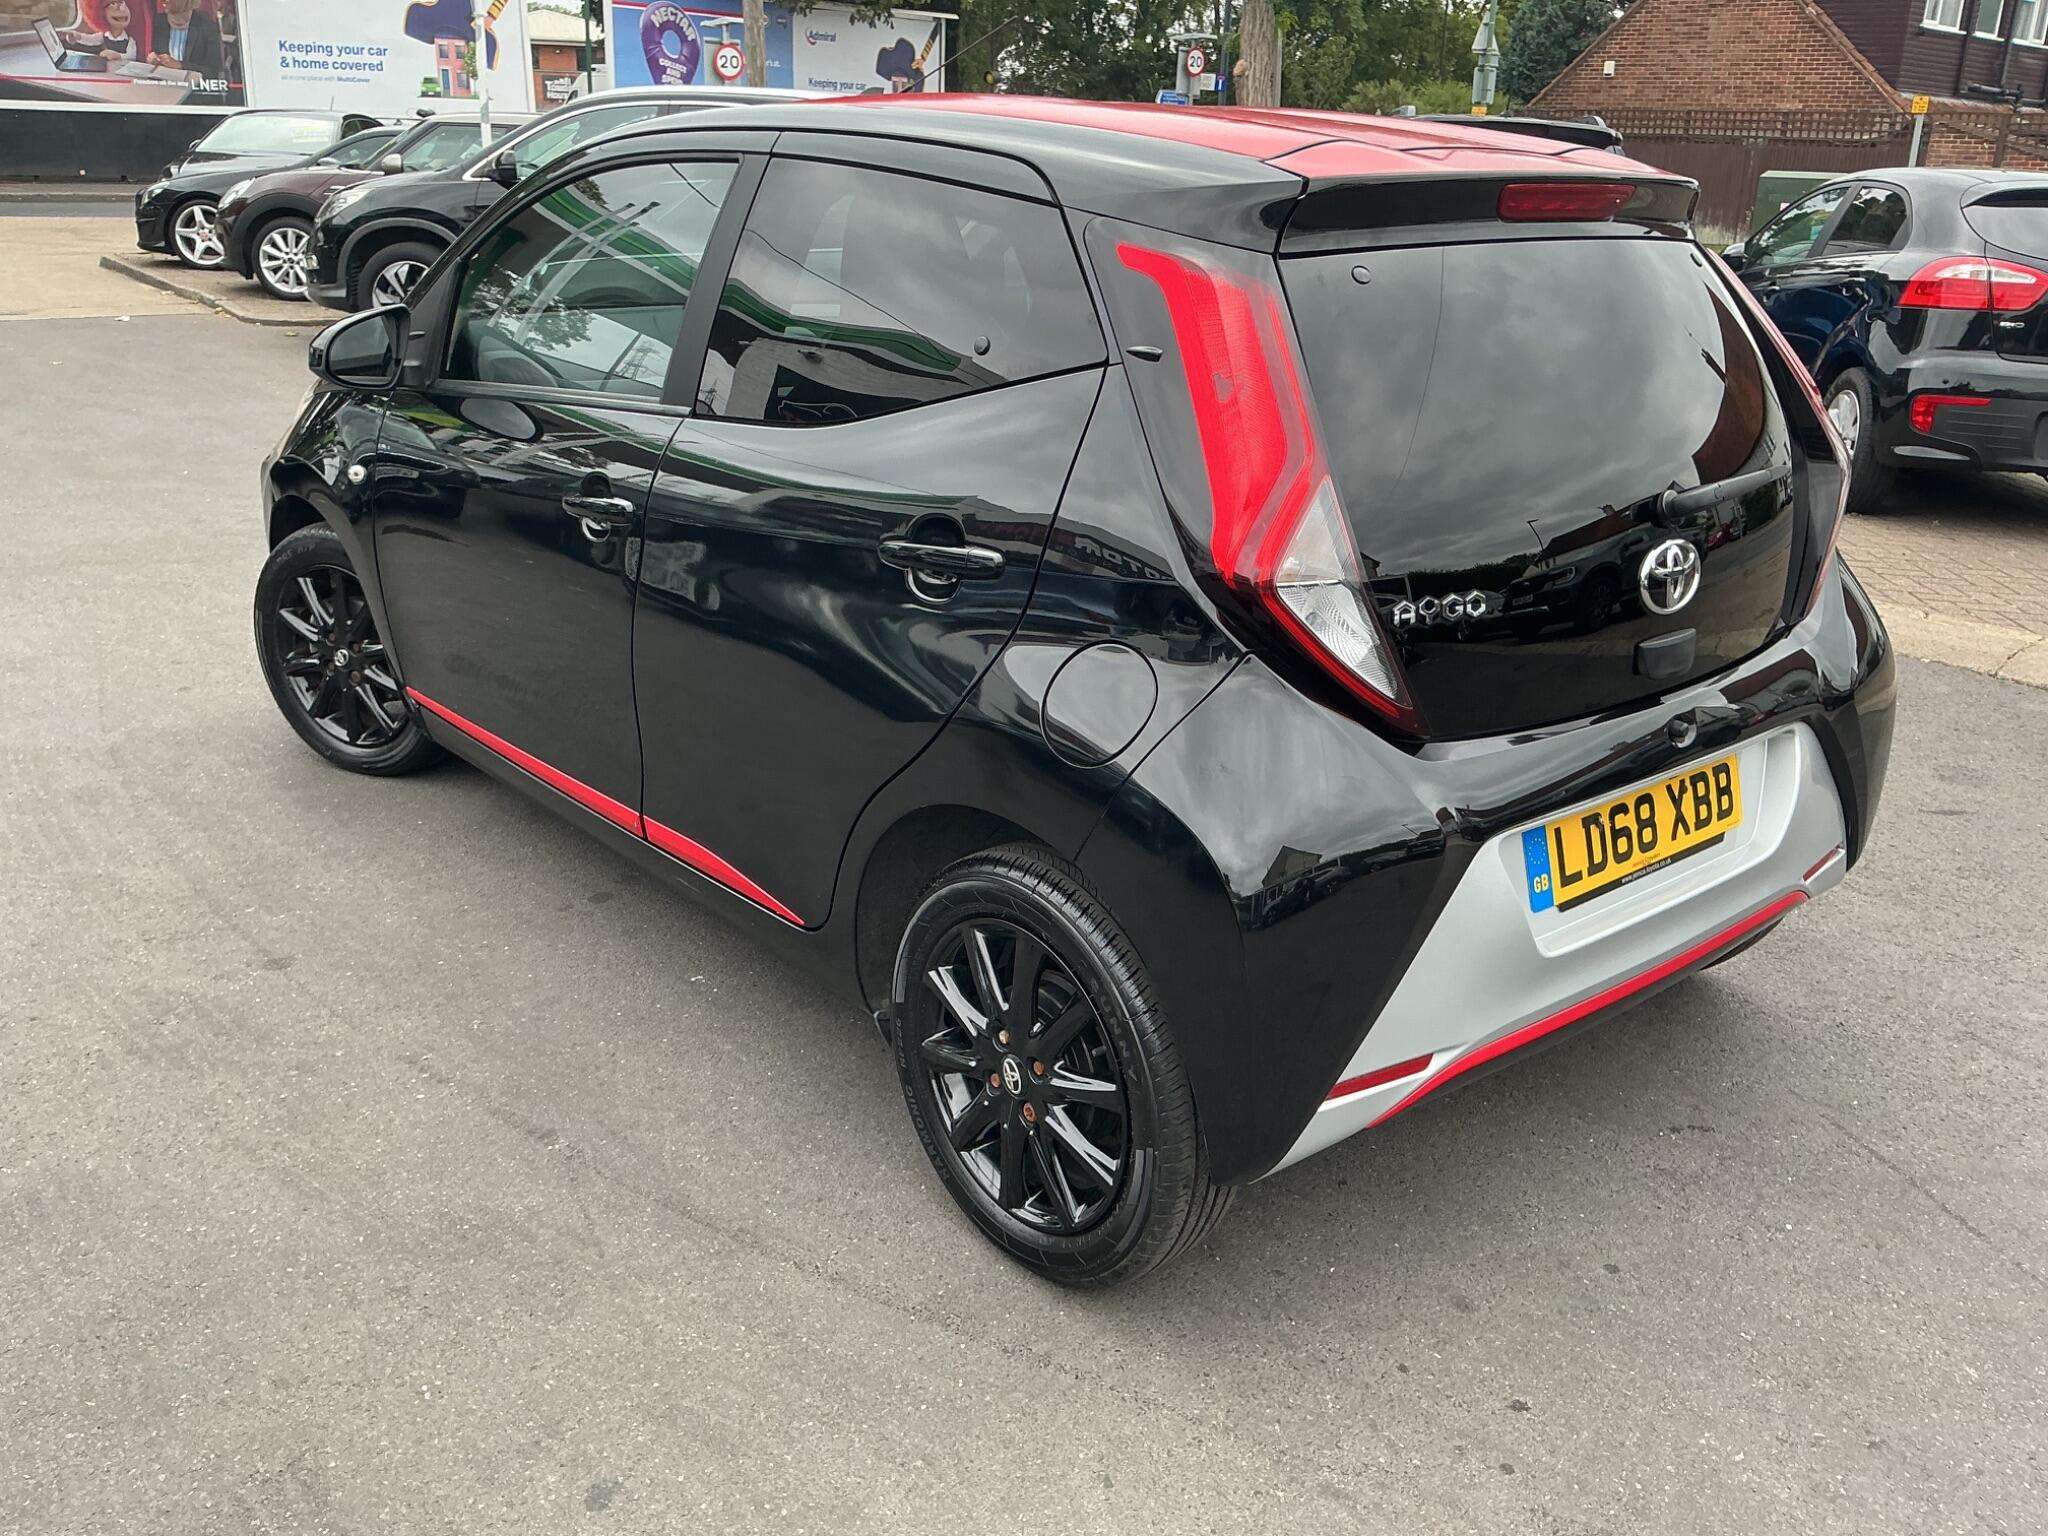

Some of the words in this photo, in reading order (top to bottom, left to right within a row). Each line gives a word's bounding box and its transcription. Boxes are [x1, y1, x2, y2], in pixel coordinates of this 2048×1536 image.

[809, 30, 837, 43] Admiral
[279, 40, 333, 56] Keeping
[336, 45, 365, 57] your
[367, 47, 388, 56] car
[280, 56, 289, 68] &
[292, 56, 329, 69] home
[332, 60, 384, 72] covered
[720, 55, 739, 69] 20
[1190, 55, 1202, 68] 20
[191, 79, 229, 91] LNER
[808, 77, 838, 90] Keeping
[839, 81, 855, 91] your
[856, 82, 867, 90] car
[1392, 590, 1487, 627] AYGO
[1554, 791, 1658, 889] LD68
[1665, 762, 1734, 842] XBB
[1533, 873, 1549, 894] GB
